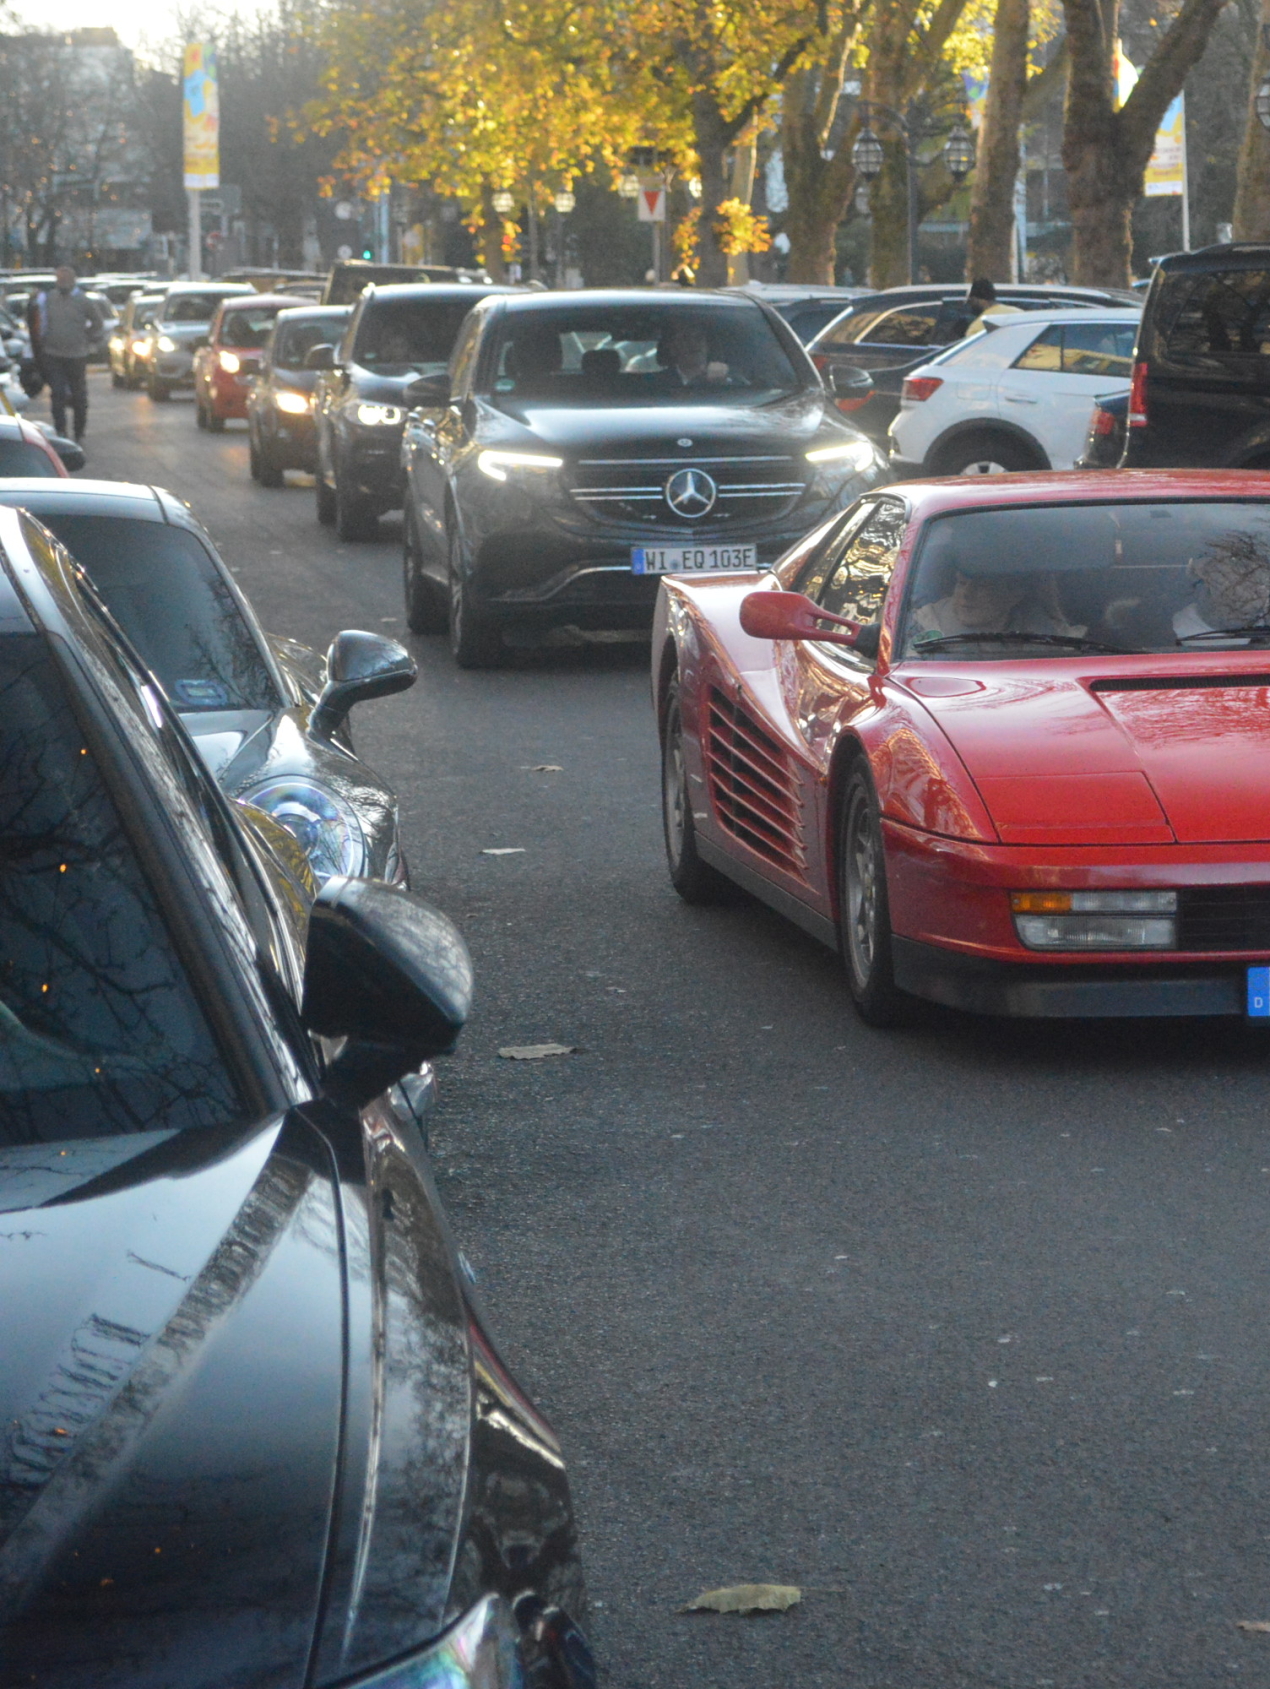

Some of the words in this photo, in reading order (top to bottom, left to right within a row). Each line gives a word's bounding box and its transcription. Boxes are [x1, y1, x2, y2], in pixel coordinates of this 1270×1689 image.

[645, 551, 667, 571] WI
[682, 549, 705, 570] EQ
[709, 548, 754, 569] 103E
[1254, 997, 1264, 1009] D
